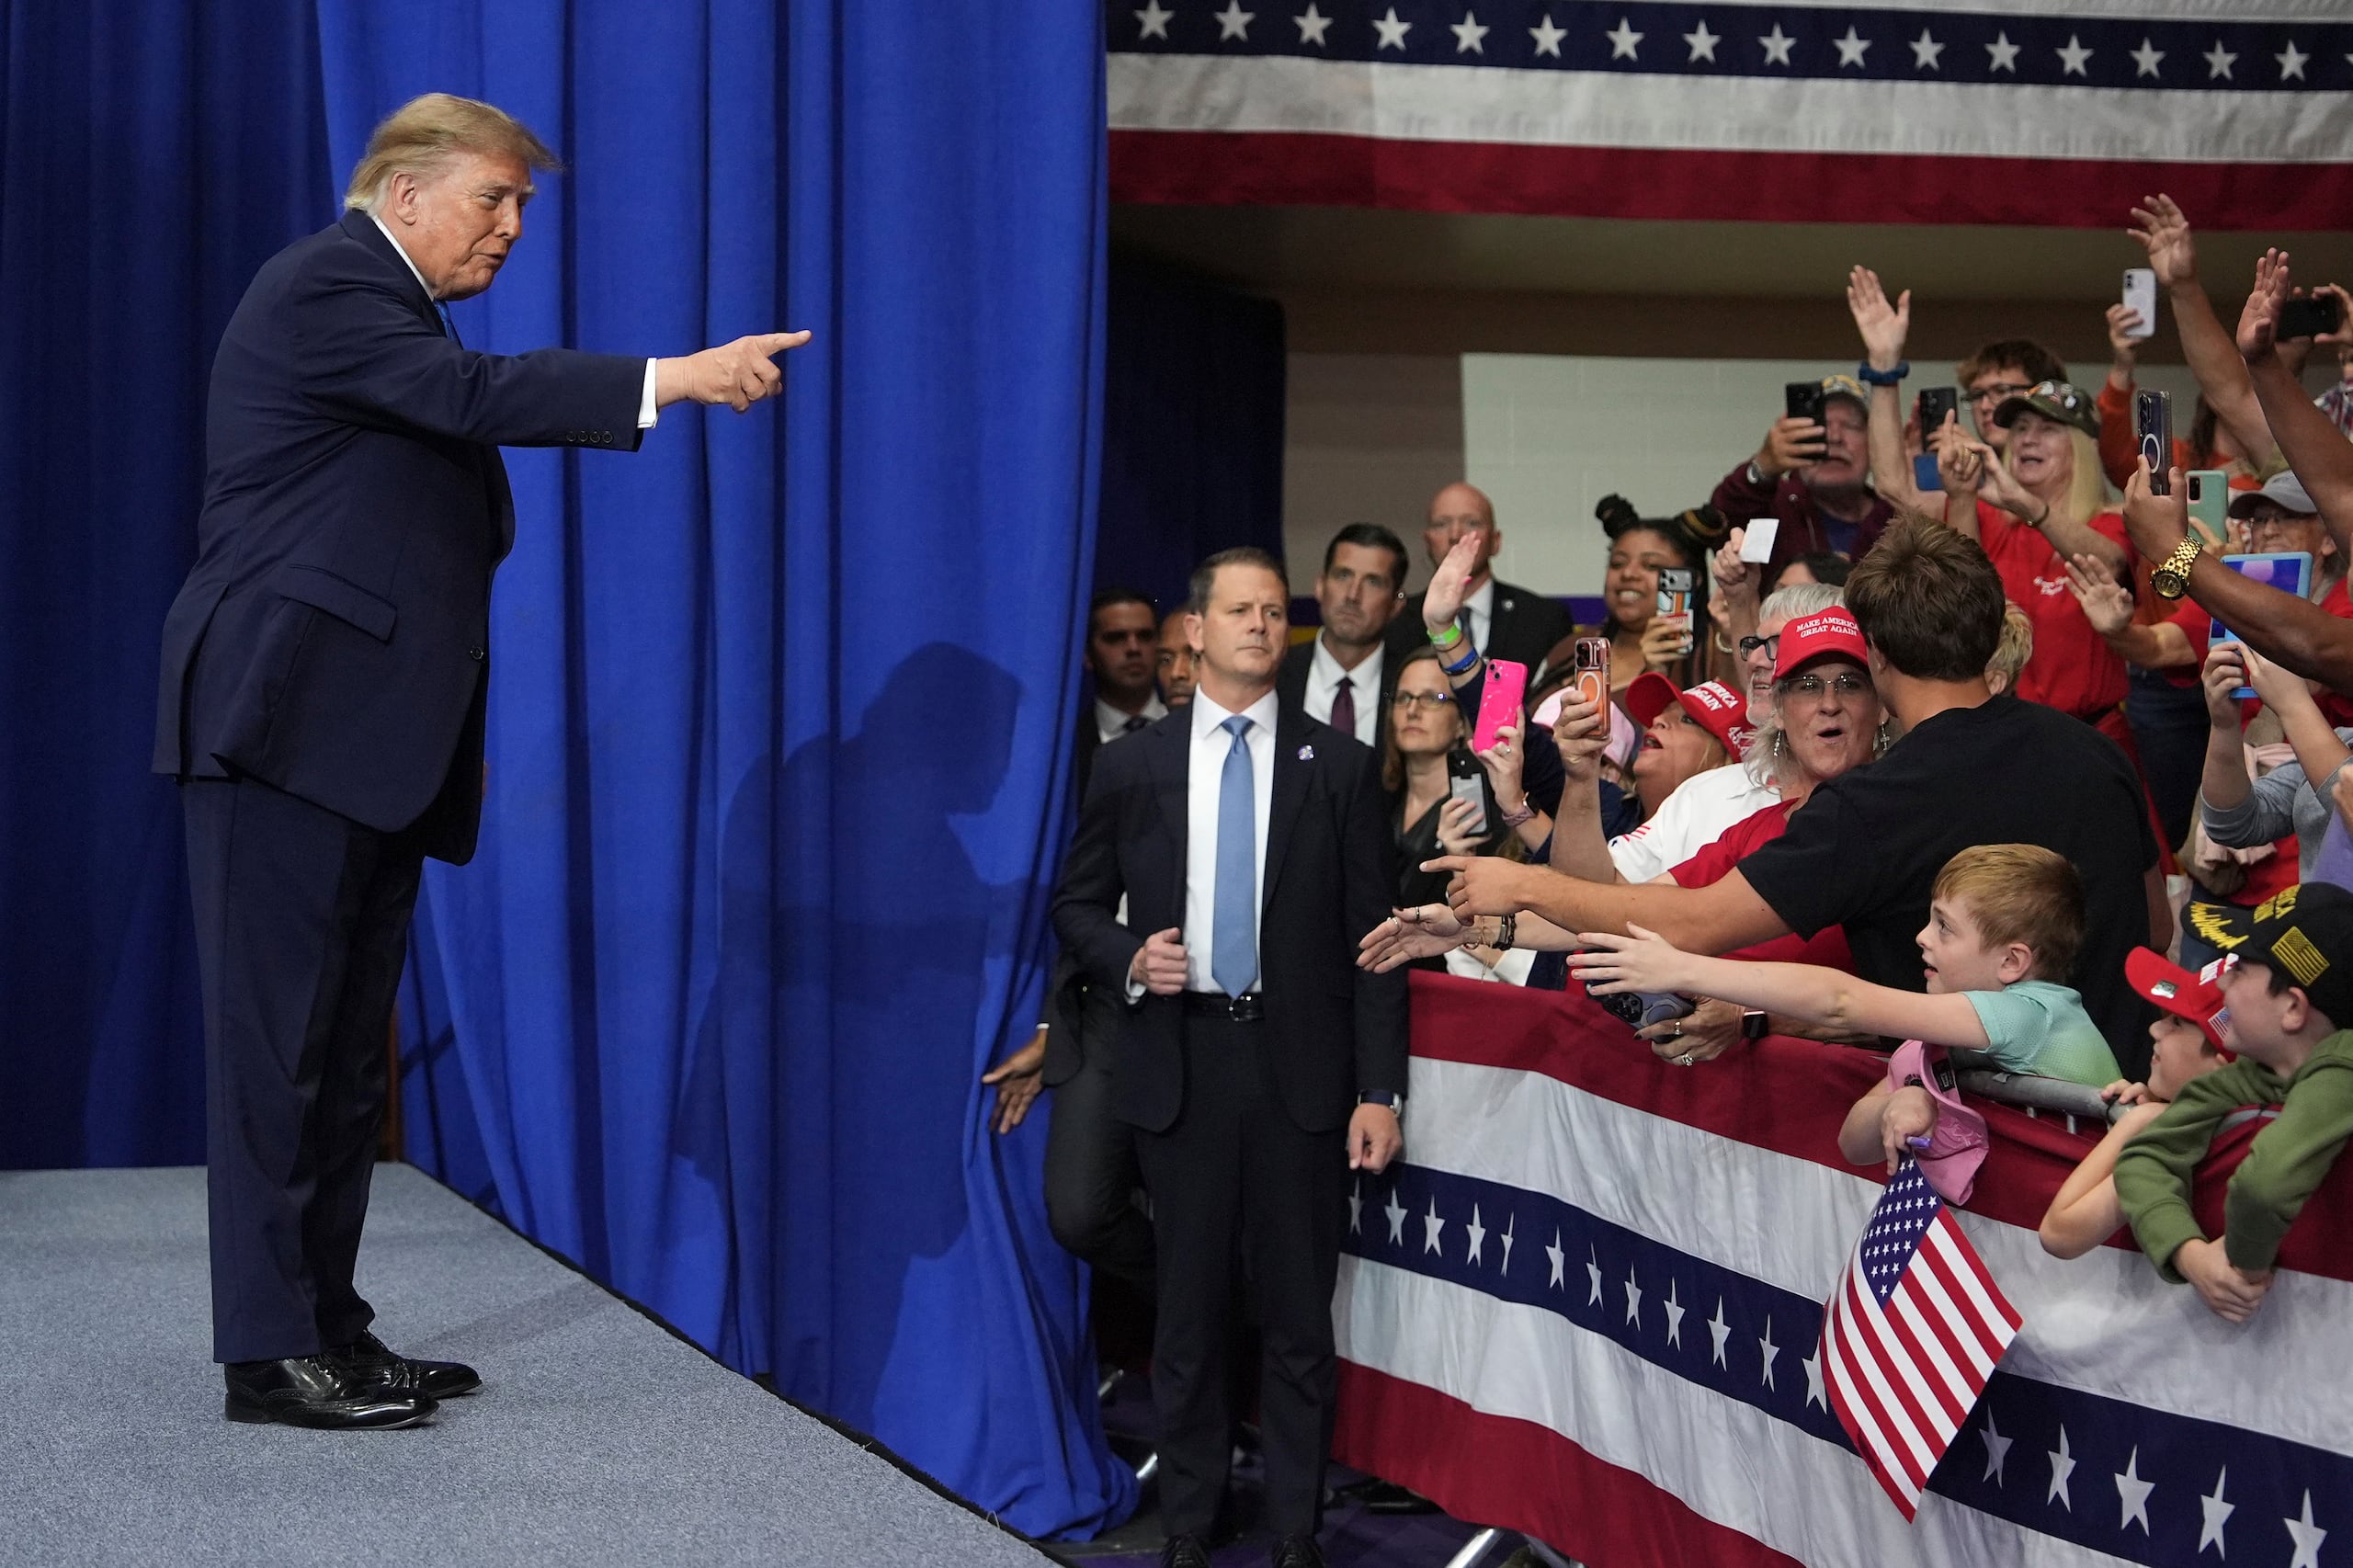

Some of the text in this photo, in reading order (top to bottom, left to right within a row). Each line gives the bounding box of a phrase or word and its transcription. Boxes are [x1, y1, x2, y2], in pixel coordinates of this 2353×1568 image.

[1796, 617, 1859, 632] MAKE AMERICA
[1801, 625, 1858, 639] GREAT AGAIN
